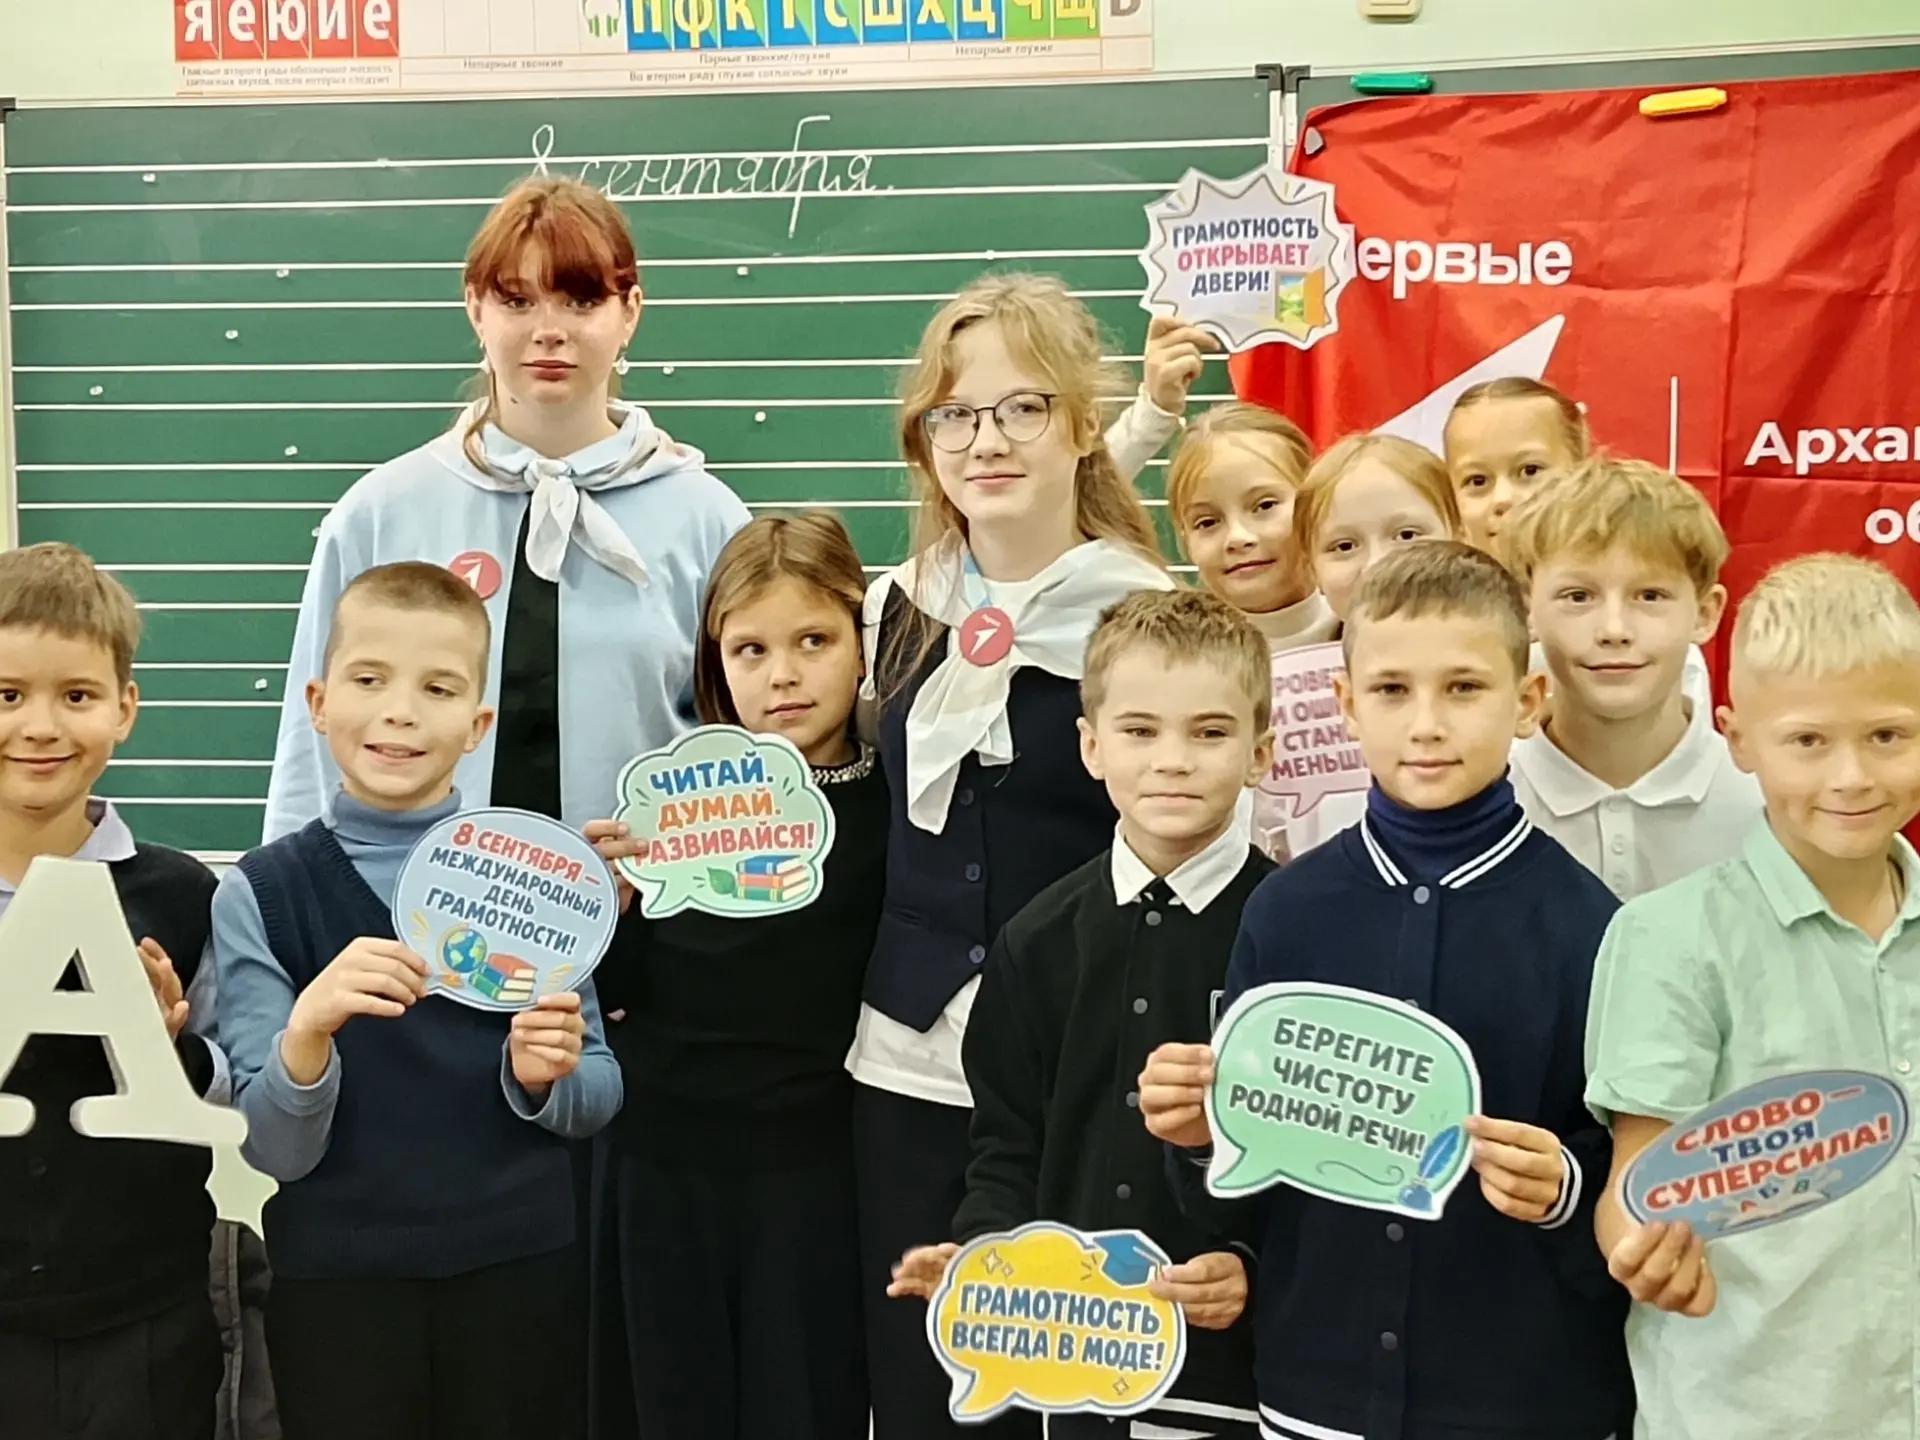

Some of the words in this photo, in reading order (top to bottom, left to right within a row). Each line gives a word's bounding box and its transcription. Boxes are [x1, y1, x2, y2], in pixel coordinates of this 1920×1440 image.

[1173, 217, 1319, 249] ГРАМОТНОСТЬ
[1178, 243, 1310, 271] ОТКРЫВАЕТ
[1191, 271, 1270, 297] ДВЕРИ!
[1357, 235, 1573, 299] ервые
[1743, 421, 1920, 475] Арха
[650, 751, 773, 795] ЧИТАЙ.
[1271, 748, 1368, 781] МЕНЬШ
[453, 823, 475, 846] 8
[658, 788, 781, 832] ДУМАЙ.
[429, 847, 602, 920] МЕЖДУНАРОДНЫЙ
[483, 885, 535, 915] ДЕНЬ
[426, 887, 577, 955] ГРАМОТНОСТИ!
[1274, 1018, 1434, 1084] БЕРЕГИТЕ
[1273, 1056, 1415, 1115] ЧИСТОТУ
[1229, 1084, 1342, 1133] РОДНОЙ
[1348, 1114, 1426, 1159] РЕЧИ!
[1675, 1091, 1821, 1152] СЛОВО
[1711, 1121, 1815, 1164] ТВОЯ
[1646, 1115, 1890, 1210] СУПЕРСИЛА!
[960, 1284, 1160, 1335] ГРАМОТНОСТЬ
[951, 1321, 1049, 1359] ВСЕГДА
[1058, 1333, 1075, 1361] В
[1082, 1340, 1165, 1372] МОДЕ!
